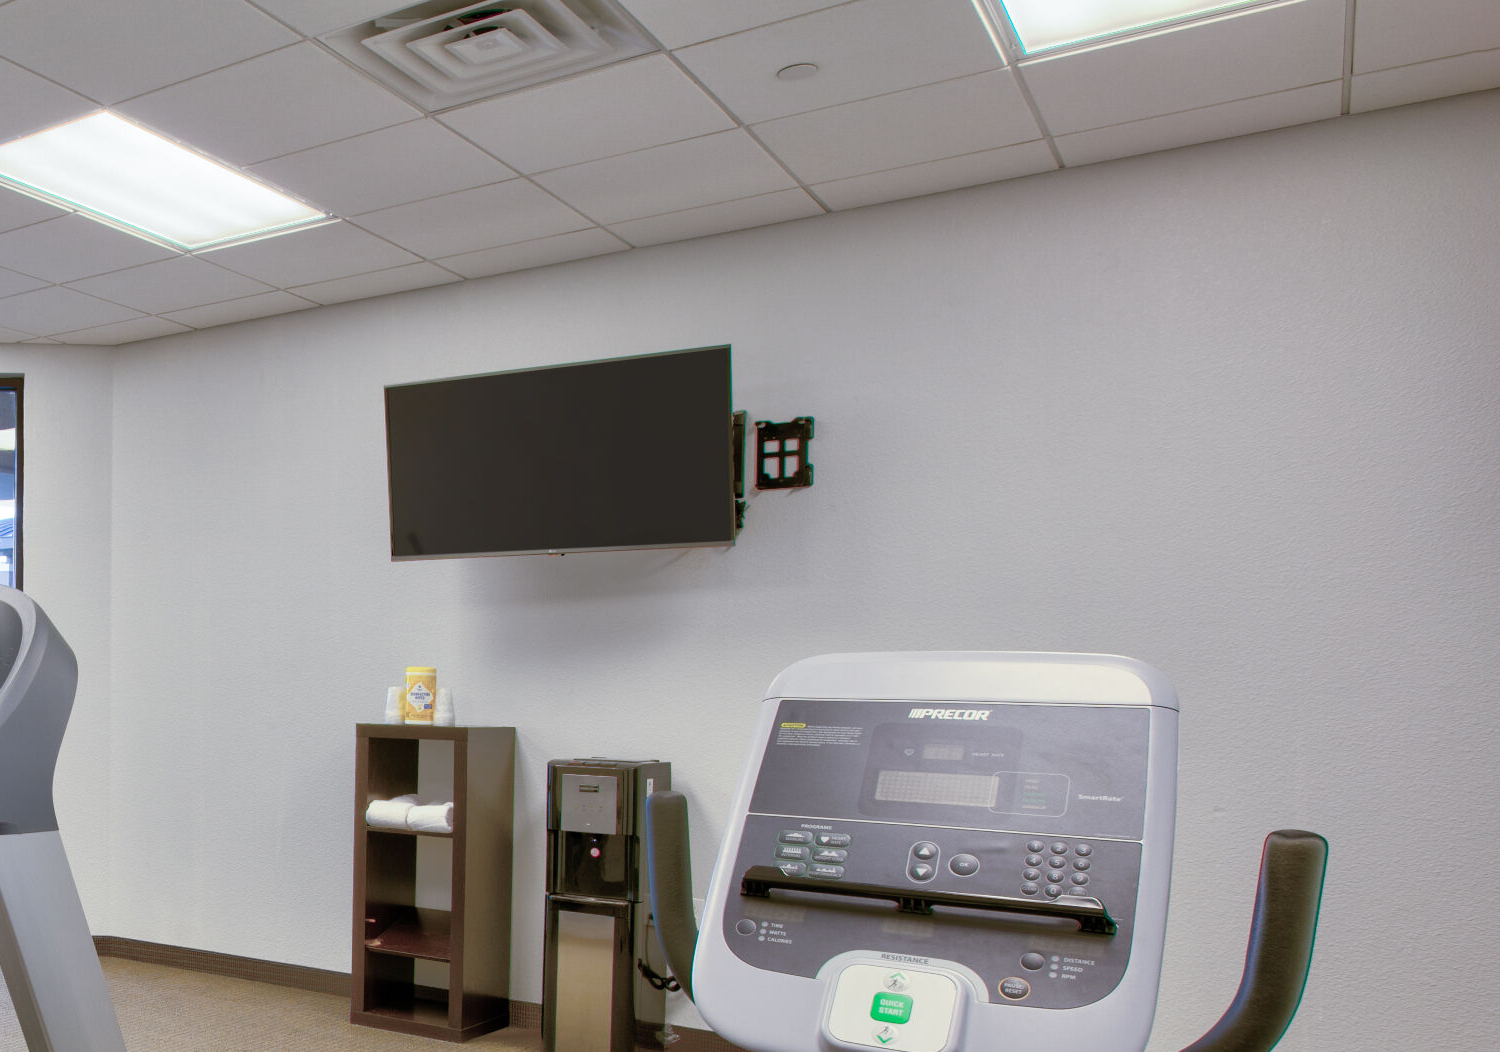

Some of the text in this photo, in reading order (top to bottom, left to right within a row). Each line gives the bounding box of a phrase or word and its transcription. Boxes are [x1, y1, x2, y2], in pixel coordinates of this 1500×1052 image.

[918, 708, 991, 720] PRECOR
[881, 953, 930, 964] RESISTANCE
[1063, 957, 1095, 965] DISTANCE
[880, 998, 904, 1008] QUICK
[878, 1006, 903, 1016] START
